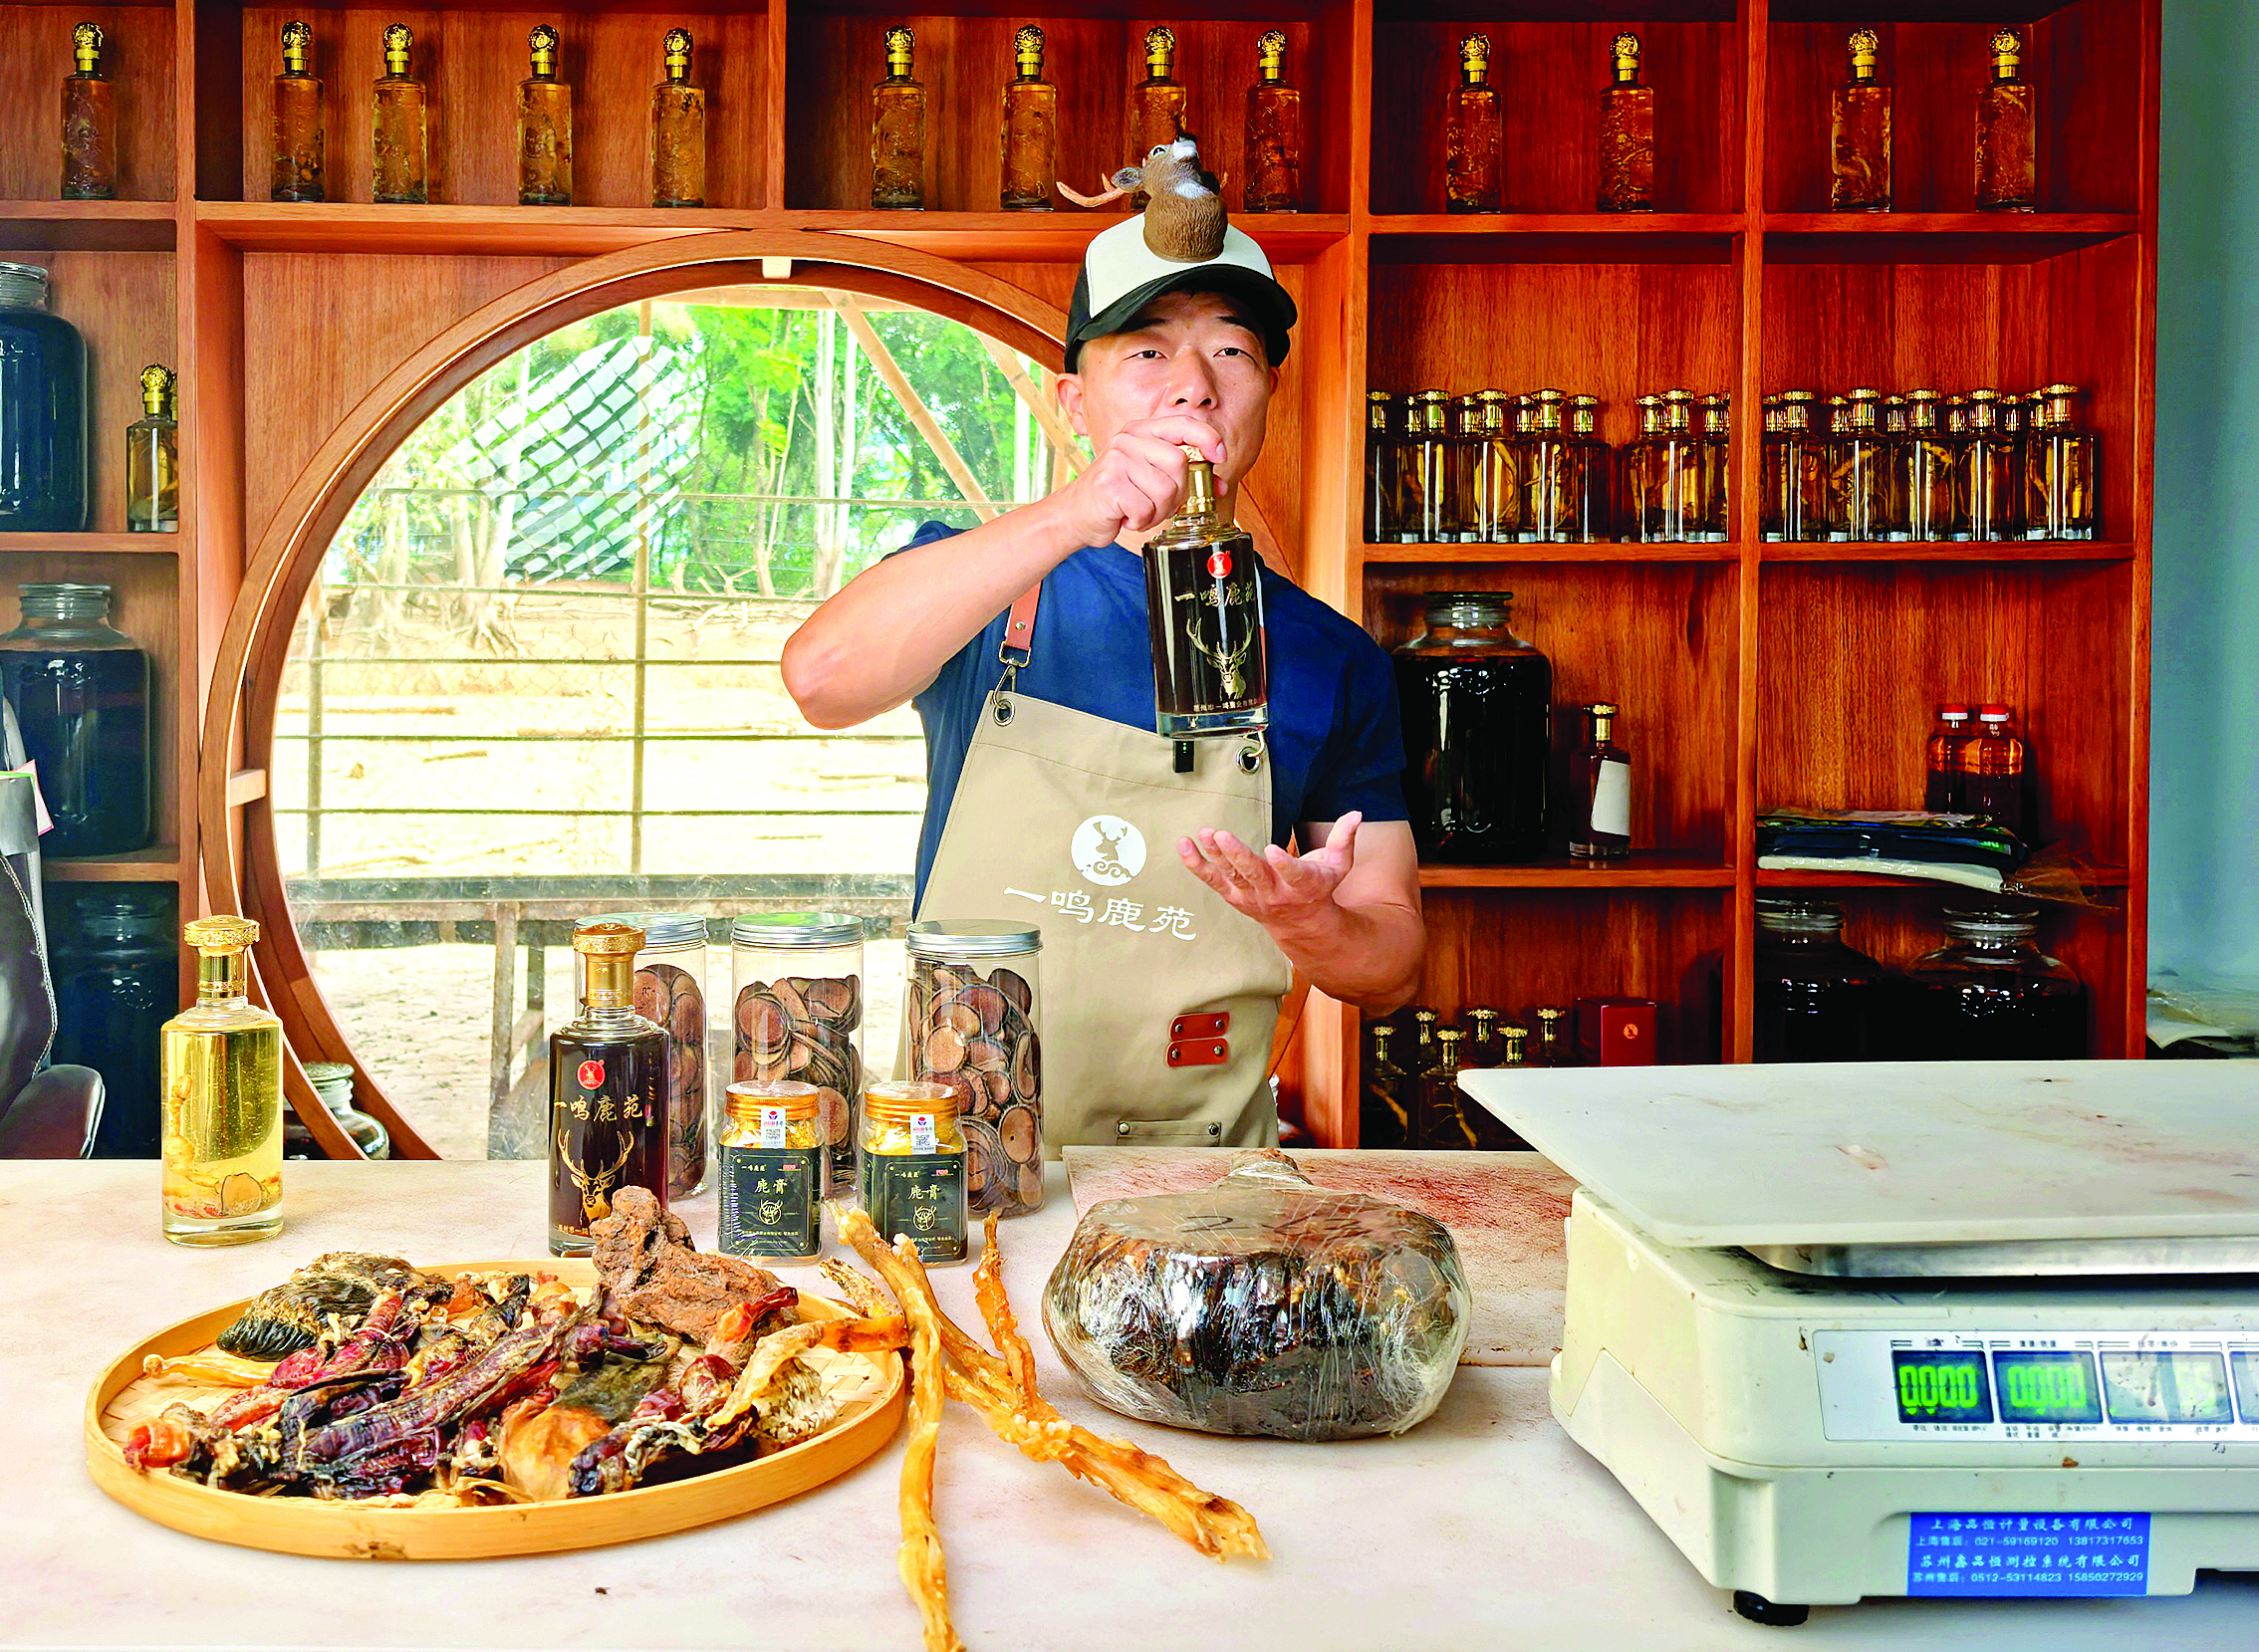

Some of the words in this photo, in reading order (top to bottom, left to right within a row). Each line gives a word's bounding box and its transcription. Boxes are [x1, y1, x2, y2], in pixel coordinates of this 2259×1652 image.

[1174, 581, 1255, 607] 一鸣鹿苑
[1002, 886, 1197, 942] 一鸣鹿苑
[554, 1094, 643, 1122] 一鸣鹿苑
[2068, 1534, 2143, 1545] 13817317653
